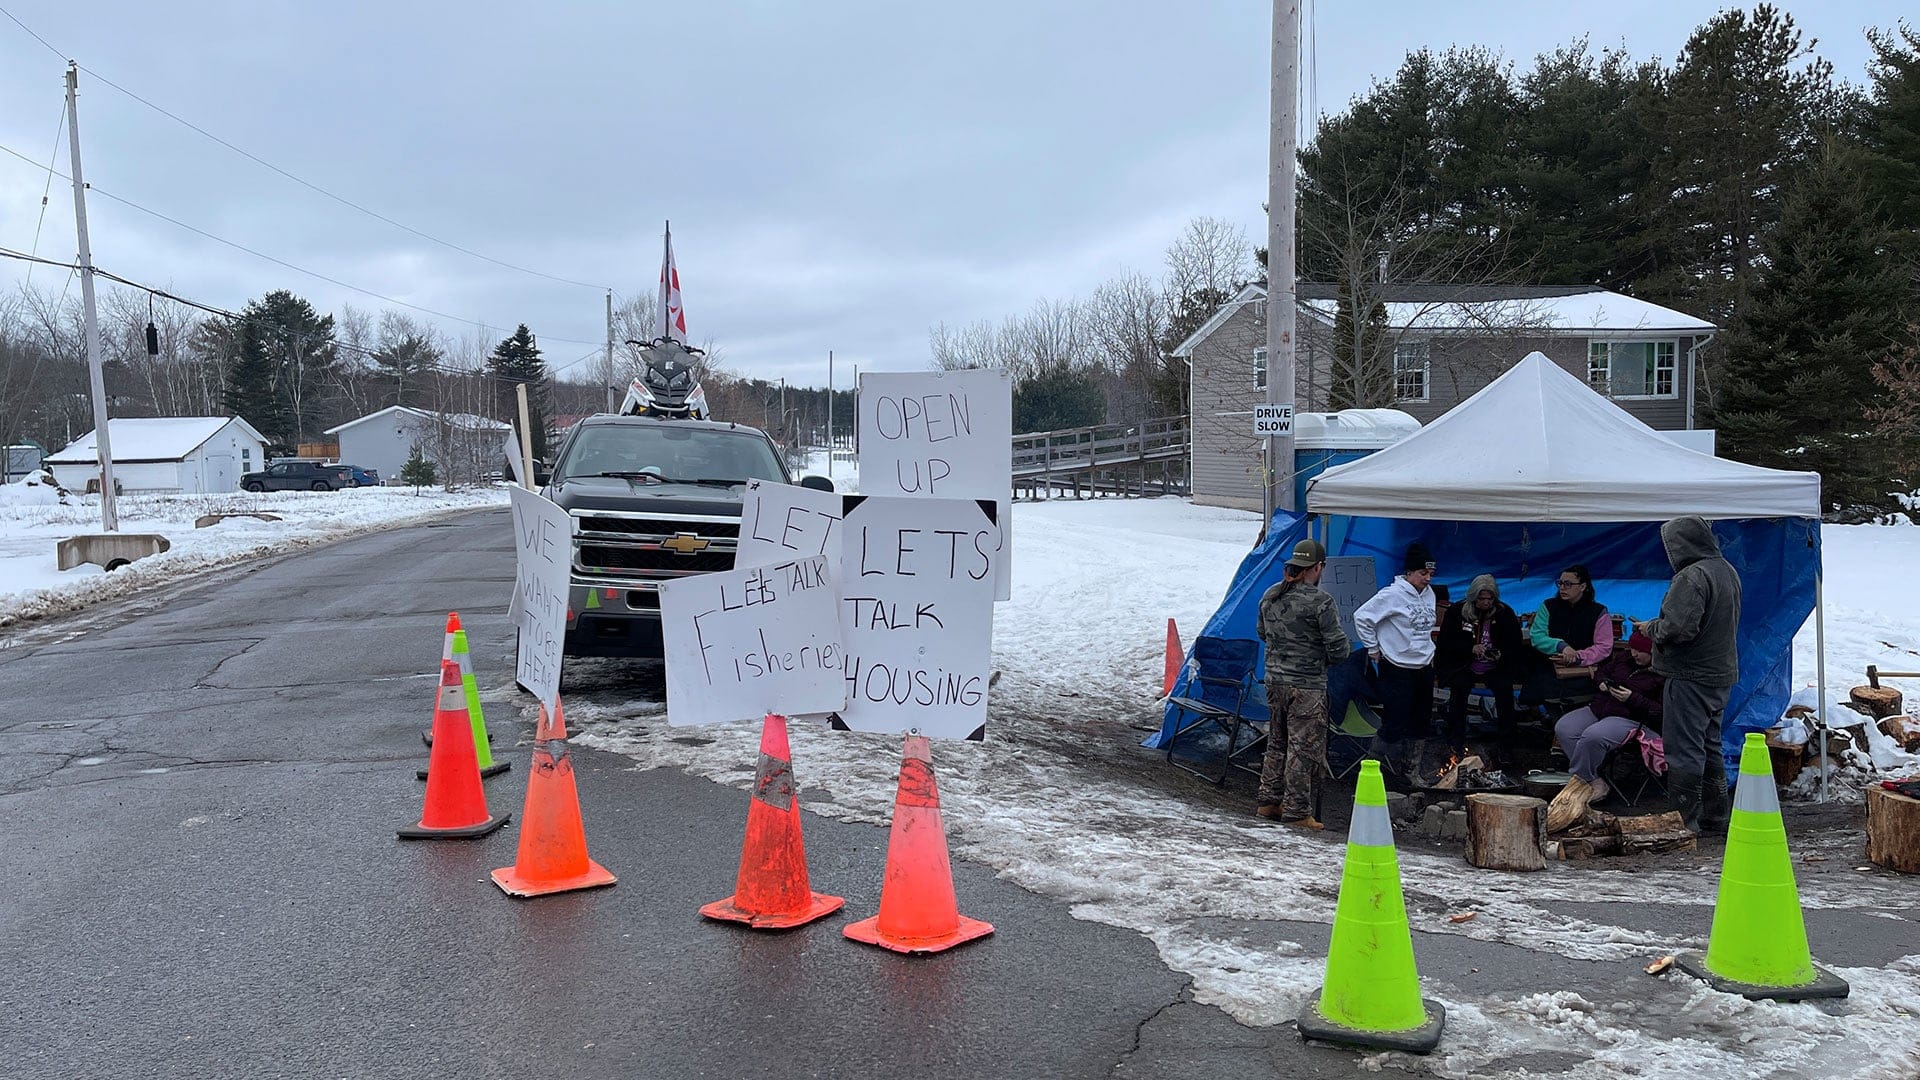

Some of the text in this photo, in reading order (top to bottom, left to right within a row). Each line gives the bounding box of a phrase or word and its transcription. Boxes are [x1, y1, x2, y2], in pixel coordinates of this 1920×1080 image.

[877, 394, 971, 443] OPEN
[1257, 408, 1291, 418] DRIVE
[1257, 421, 1290, 431] SLOW
[897, 459, 951, 494] UP
[517, 502, 557, 564] WE
[752, 496, 843, 564] LET
[861, 526, 989, 580] LETS
[521, 563, 562, 629] WANT
[774, 560, 826, 597] TALK
[1321, 565, 1376, 585] ETS
[844, 598, 943, 630] TALK
[694, 609, 843, 685] Fisheries
